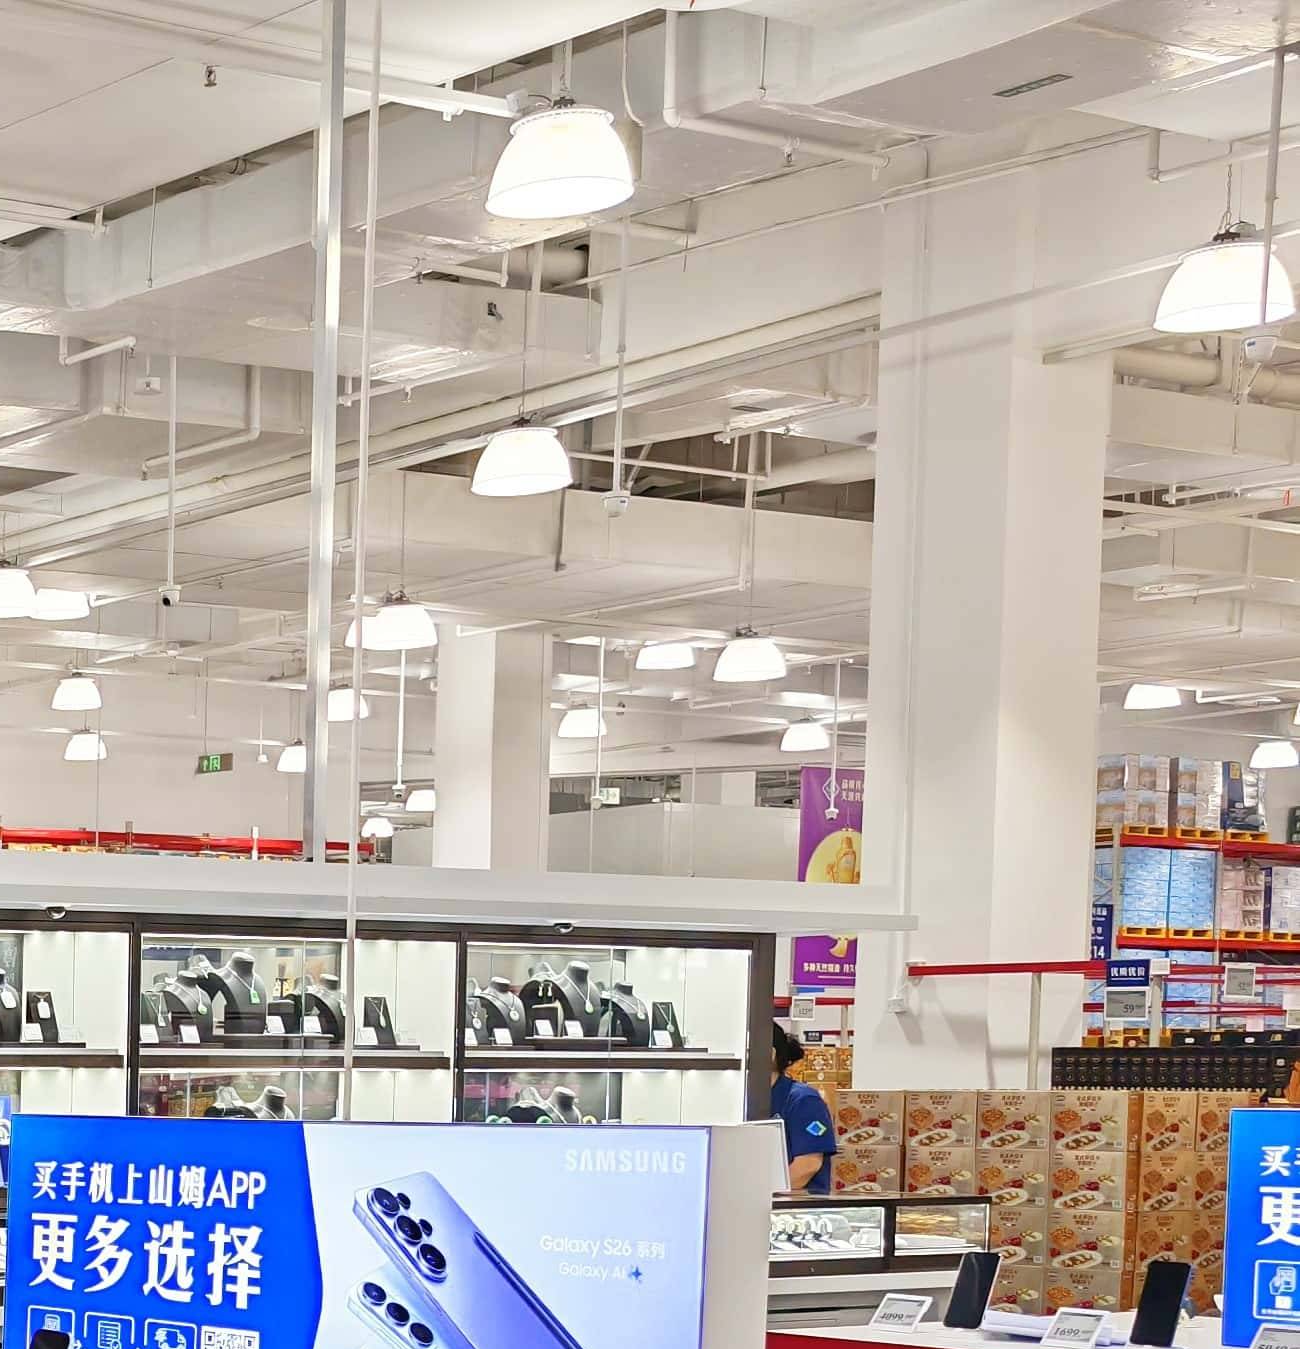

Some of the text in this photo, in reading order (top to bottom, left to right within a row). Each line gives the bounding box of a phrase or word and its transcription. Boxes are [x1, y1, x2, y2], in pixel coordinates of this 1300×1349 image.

[565, 1149, 686, 1174] SAMSUNG
[1259, 1145, 1300, 1176] 买
[32, 1160, 266, 1209] 买手机上山姆APP
[540, 1234, 665, 1259] Galaxy S26 系列
[29, 1212, 263, 1310] 更多选择
[559, 1262, 626, 1281] Galaxy AI
